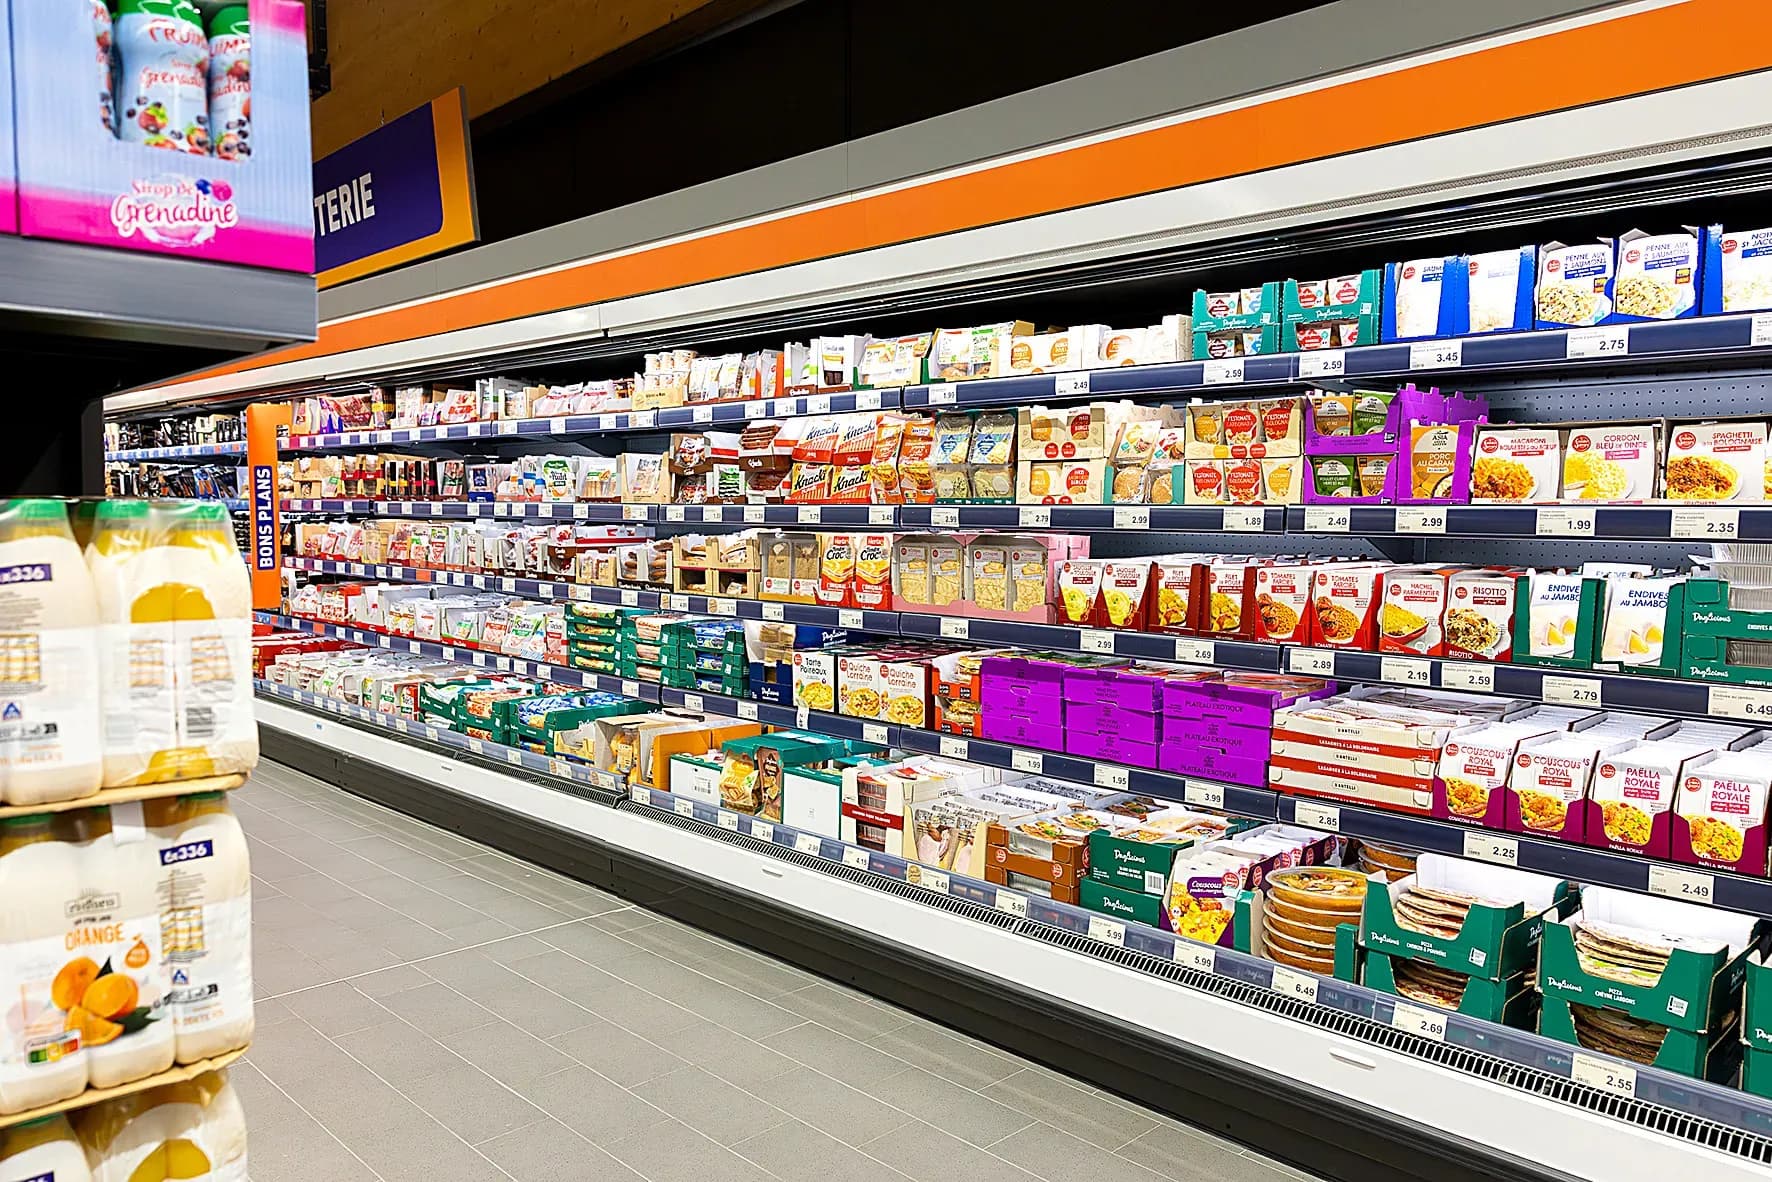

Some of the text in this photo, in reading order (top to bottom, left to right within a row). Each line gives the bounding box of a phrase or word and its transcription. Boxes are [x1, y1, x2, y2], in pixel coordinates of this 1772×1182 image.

[315, 173, 375, 237] TERIE
[114, 195, 235, 231] Grenadine
[1599, 340, 1625, 350] 2.75
[1437, 352, 1459, 363] 3.45
[1323, 360, 1343, 370] 2.59
[1225, 369, 1242, 379] 2.59
[1604, 434, 1640, 442] CORDON
[1712, 431, 1753, 439] SPAGHETTI
[1596, 441, 1647, 450] BLEU DINDE
[1713, 437, 1763, 446] BOLOGNAISE
[257, 468, 273, 568] BONS PLANS
[1132, 516, 1147, 524] 2.99
[1245, 517, 1262, 526] 1.89
[1328, 517, 1347, 526] 2.49
[1422, 517, 1442, 527] 2.99
[1567, 520, 1591, 530] 1.99
[1707, 522, 1734, 533] 2.35
[1403, 589, 1440, 597] PARMENTIER
[1473, 587, 1507, 596] RISOTTO
[1097, 641, 1112, 649] 2.99
[1195, 650, 1211, 659] 2.69
[806, 658, 821, 666] Tarte
[1313, 660, 1332, 669] 2.89
[848, 662, 871, 673] Quiche
[846, 670, 873, 682] Lorraine
[889, 668, 914, 680] Quiche
[1407, 671, 1428, 680] 2.19
[888, 676, 916, 688] Lorraine
[1468, 675, 1490, 685] 2.59
[1573, 690, 1597, 700] 2.79
[1185, 700, 1245, 713] PLATEAU EXOTIQUE
[1745, 704, 1772, 715] 6.49
[1184, 733, 1243, 747] PLATEAU EXOTIQUE
[1461, 746, 1505, 759] COUSCOUS
[1468, 757, 1494, 767] ROYAL
[1534, 757, 1581, 769] COUSCOUS
[1181, 764, 1238, 779] PLATEAU EXOTIQUE
[1543, 767, 1569, 777] ROYAL
[1626, 768, 1660, 780] PAËLLA
[1112, 776, 1126, 785] 1.95
[1625, 778, 1660, 789] ROYALE
[1714, 780, 1750, 793] PAËLLA
[1204, 793, 1221, 802] 3.99
[1712, 791, 1750, 803] ROYALE
[1318, 815, 1337, 826] 2.85
[1492, 846, 1515, 858] 2.25
[1191, 880, 1222, 888] Couscous
[1682, 884, 1708, 896] 2.49
[65, 923, 125, 951] ORANGE
[1107, 930, 1122, 940] 5.99
[1194, 955, 1212, 967] 5.99
[1295, 984, 1315, 996] 6.49
[1420, 1020, 1443, 1034] 2.69
[1606, 1075, 1632, 1091] 2.55
